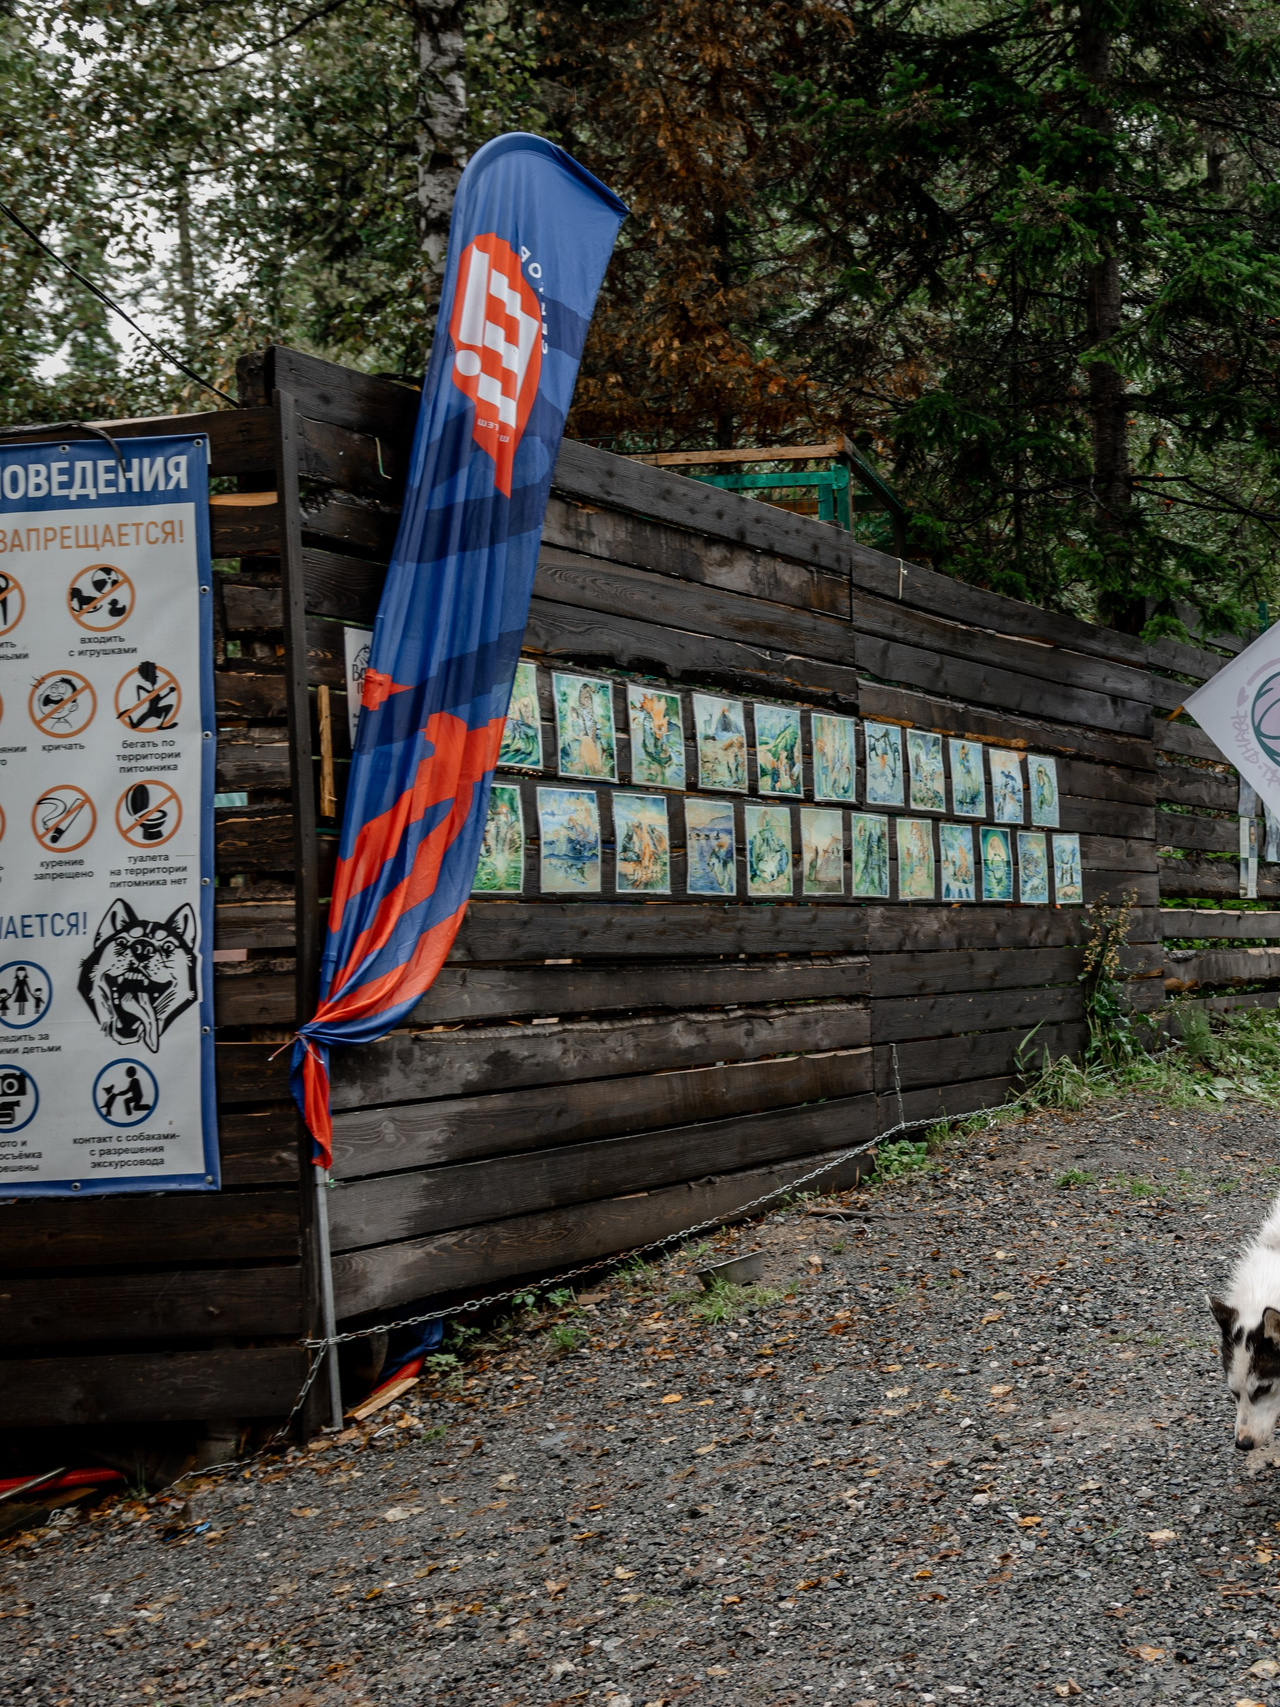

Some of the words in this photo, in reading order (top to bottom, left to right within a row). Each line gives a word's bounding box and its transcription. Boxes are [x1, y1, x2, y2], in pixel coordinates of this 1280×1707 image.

[0, 455, 188, 500] ОВЕДЕНИЯ
[80, 635, 125, 645] входить
[68, 648, 75, 657] с
[78, 646, 138, 658] игрушками
[42, 743, 86, 753] кричать
[121, 739, 159, 750] бегать
[161, 739, 176, 748] по
[116, 750, 181, 762] территории
[119, 763, 178, 774] питомника
[39, 858, 84, 869] курение
[127, 854, 170, 864] туалета
[33, 870, 94, 881] запрещено
[109, 868, 122, 877] на
[124, 864, 188, 877] территории
[109, 877, 167, 889] питомника
[170, 877, 188, 886] нет
[0, 911, 88, 940] АЕТСЯ!
[38, 1033, 49, 1041] за
[22, 1045, 62, 1055] детьми
[72, 1135, 113, 1145] контакт
[125, 1131, 181, 1142] собаками-
[89, 1149, 96, 1157] с
[99, 1144, 165, 1157] разрешения
[90, 1157, 165, 1169] экскурсовода
